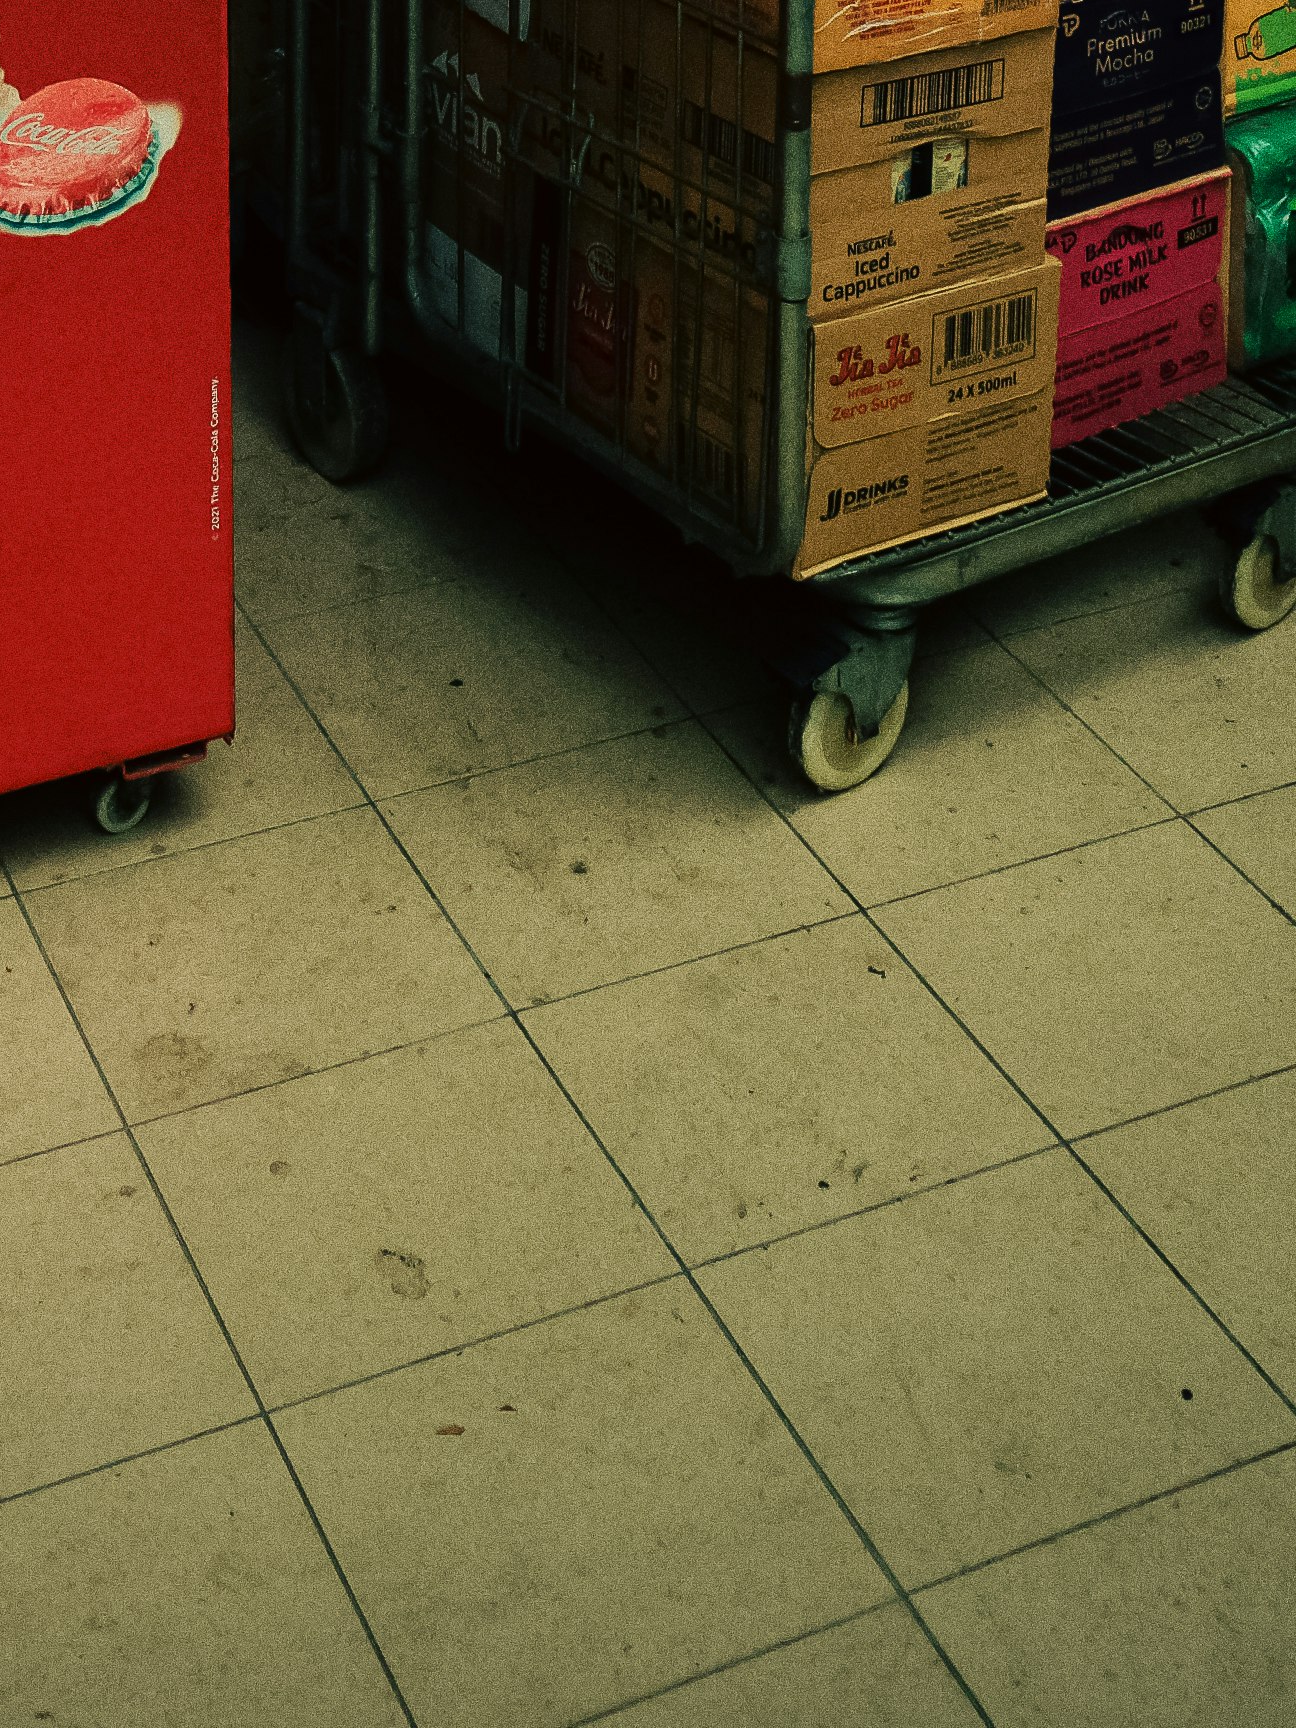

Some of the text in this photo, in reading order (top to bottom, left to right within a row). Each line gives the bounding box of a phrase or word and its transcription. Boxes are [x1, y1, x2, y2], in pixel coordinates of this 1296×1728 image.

[1087, 26, 1163, 57] Premium
[1095, 48, 1154, 76] Mocha
[847, 230, 894, 257] NESCAFÉ
[855, 252, 890, 276] Iced
[1081, 245, 1168, 287] ROSE MILK
[823, 265, 920, 303] Cappuccino
[1100, 273, 1149, 305] DRINK
[948, 371, 1017, 402] 24 X 500ml
[831, 391, 914, 422] Zero Sugar
[210, 376, 220, 530] 2021 The Coca-Cola Company.
[844, 475, 909, 504] DRINKS
